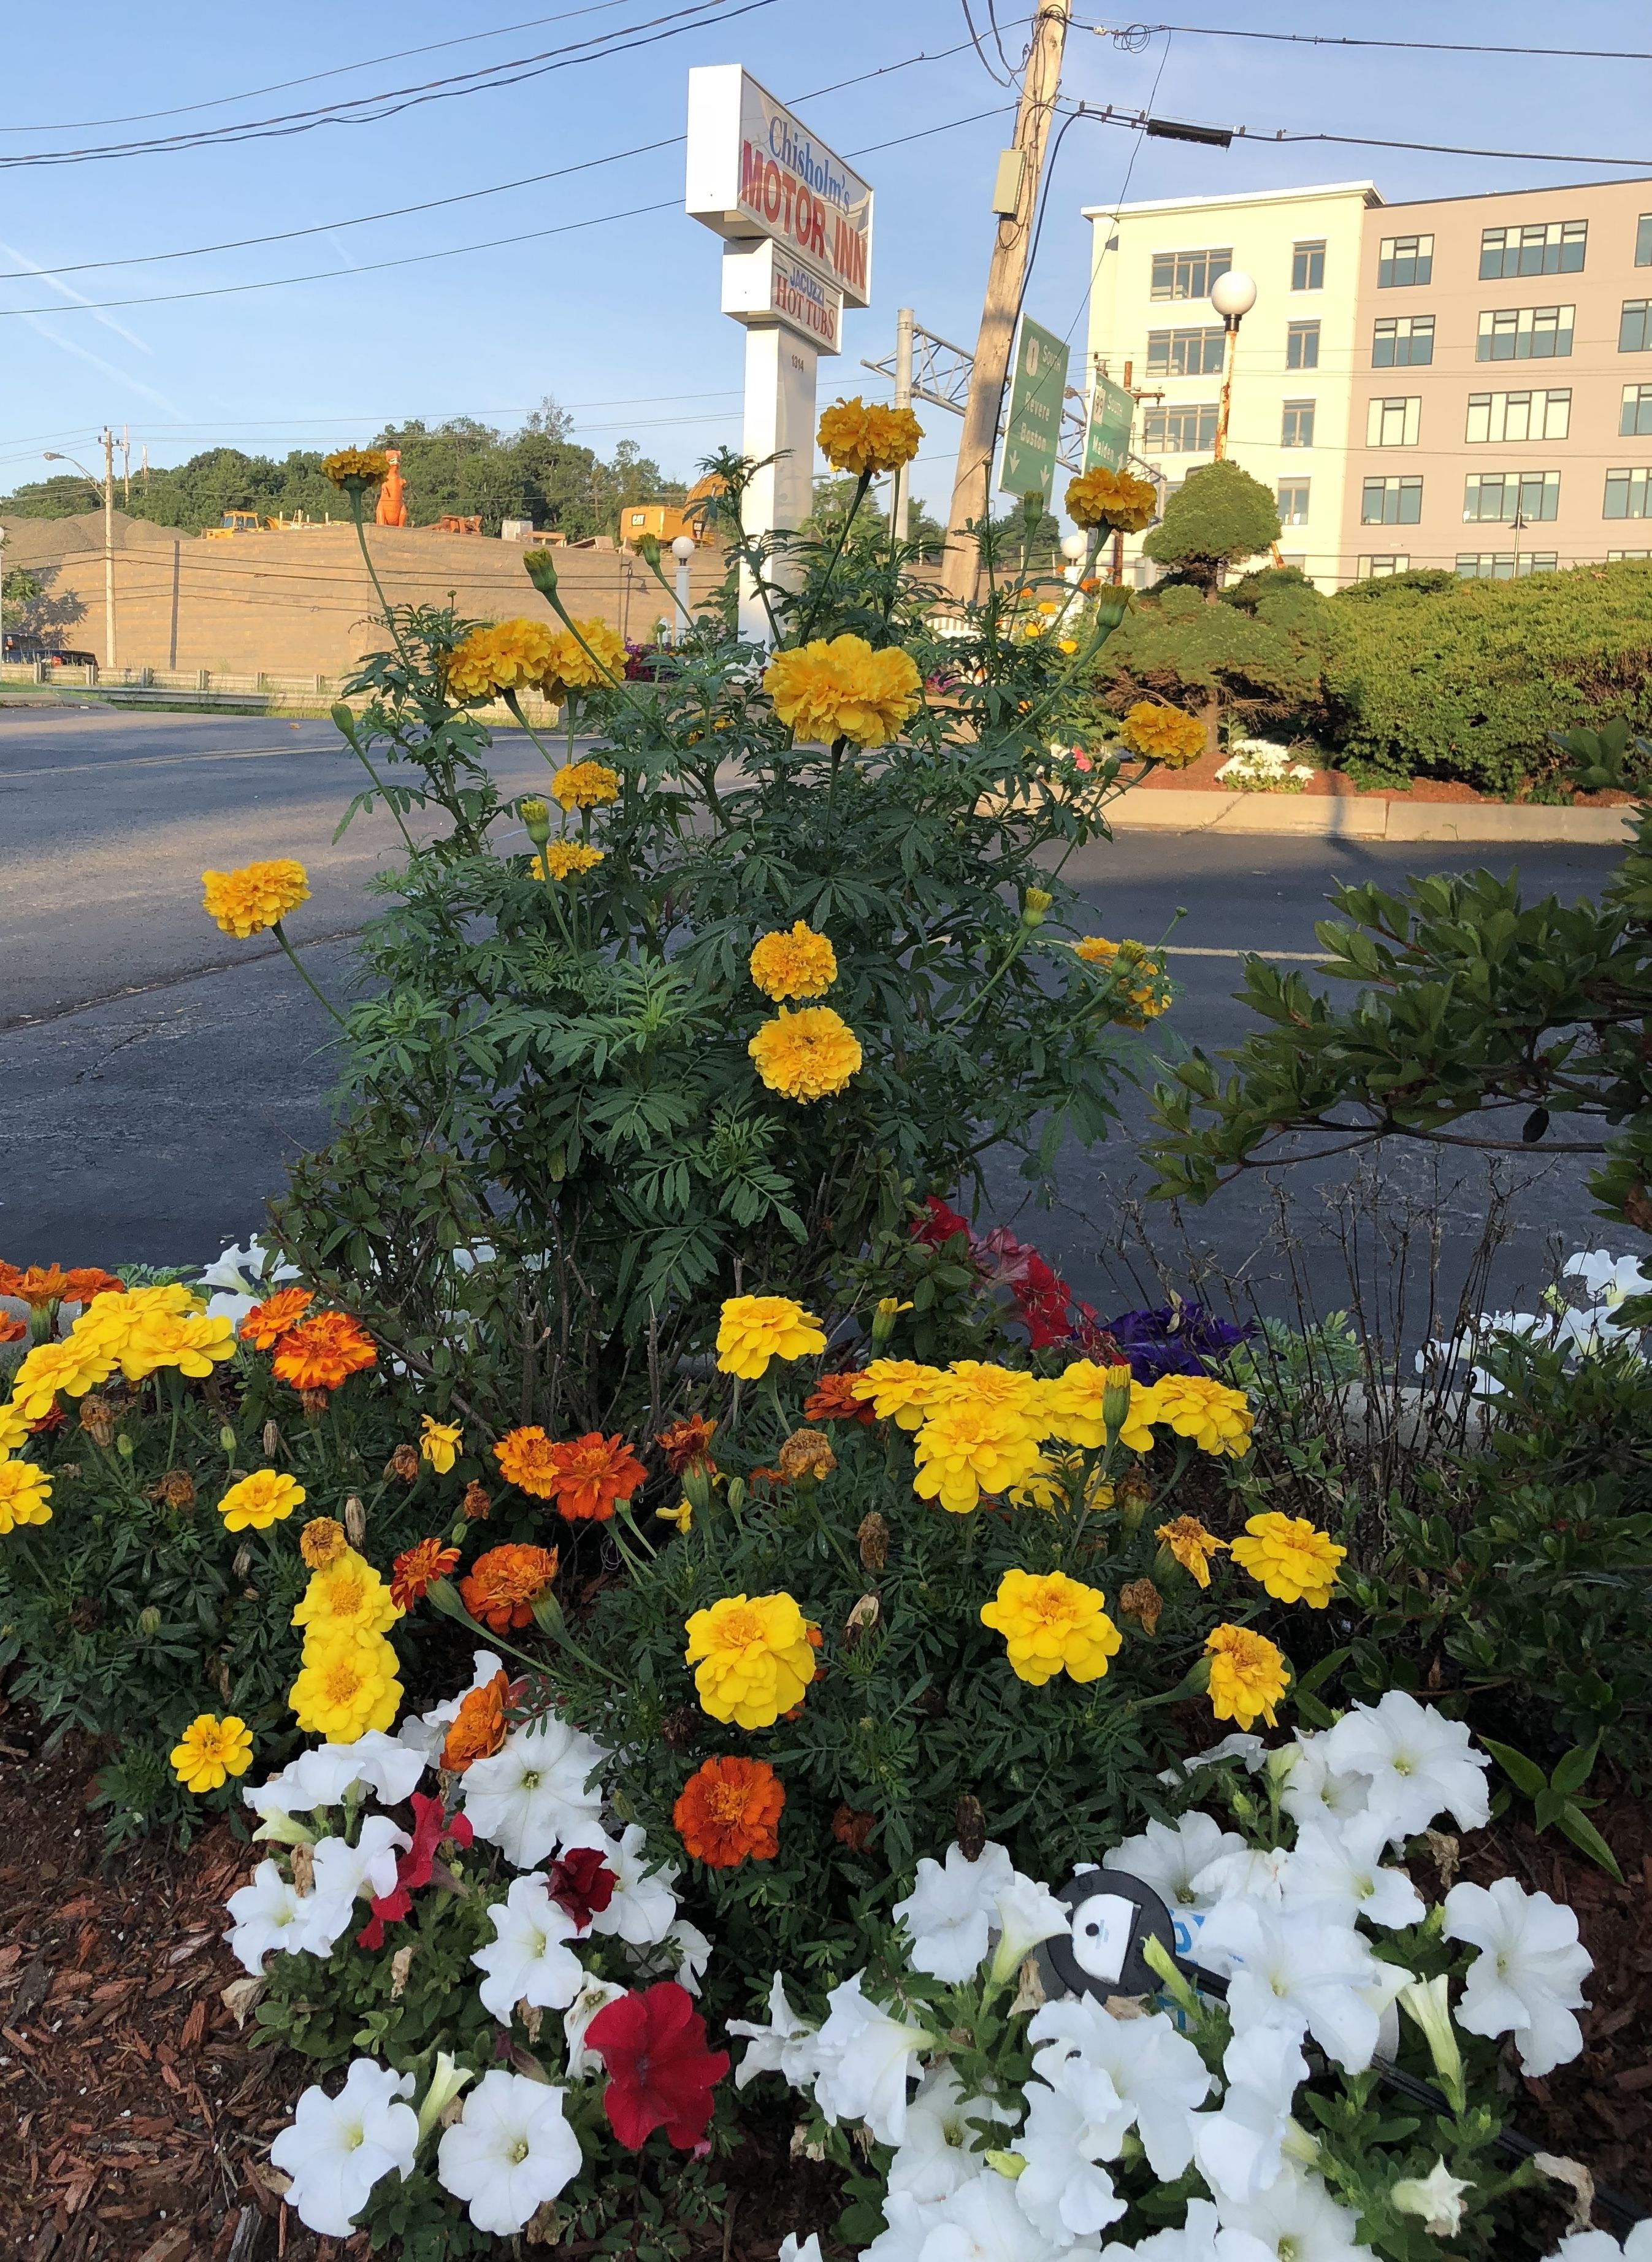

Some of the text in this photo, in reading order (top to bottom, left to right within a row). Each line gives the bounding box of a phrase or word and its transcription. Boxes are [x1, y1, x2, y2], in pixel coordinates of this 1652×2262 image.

[769, 116, 850, 216] Chisholm's
[741, 139, 866, 290] MOTOR INN
[790, 266, 824, 307] JACUZZI
[775, 272, 835, 340] HOT TUBS
[791, 355, 804, 372] 1314
[1025, 391, 1050, 421] Revere
[1095, 395, 1103, 416] 99
[1020, 421, 1047, 452] Boston
[1092, 434, 1114, 463] Malden
